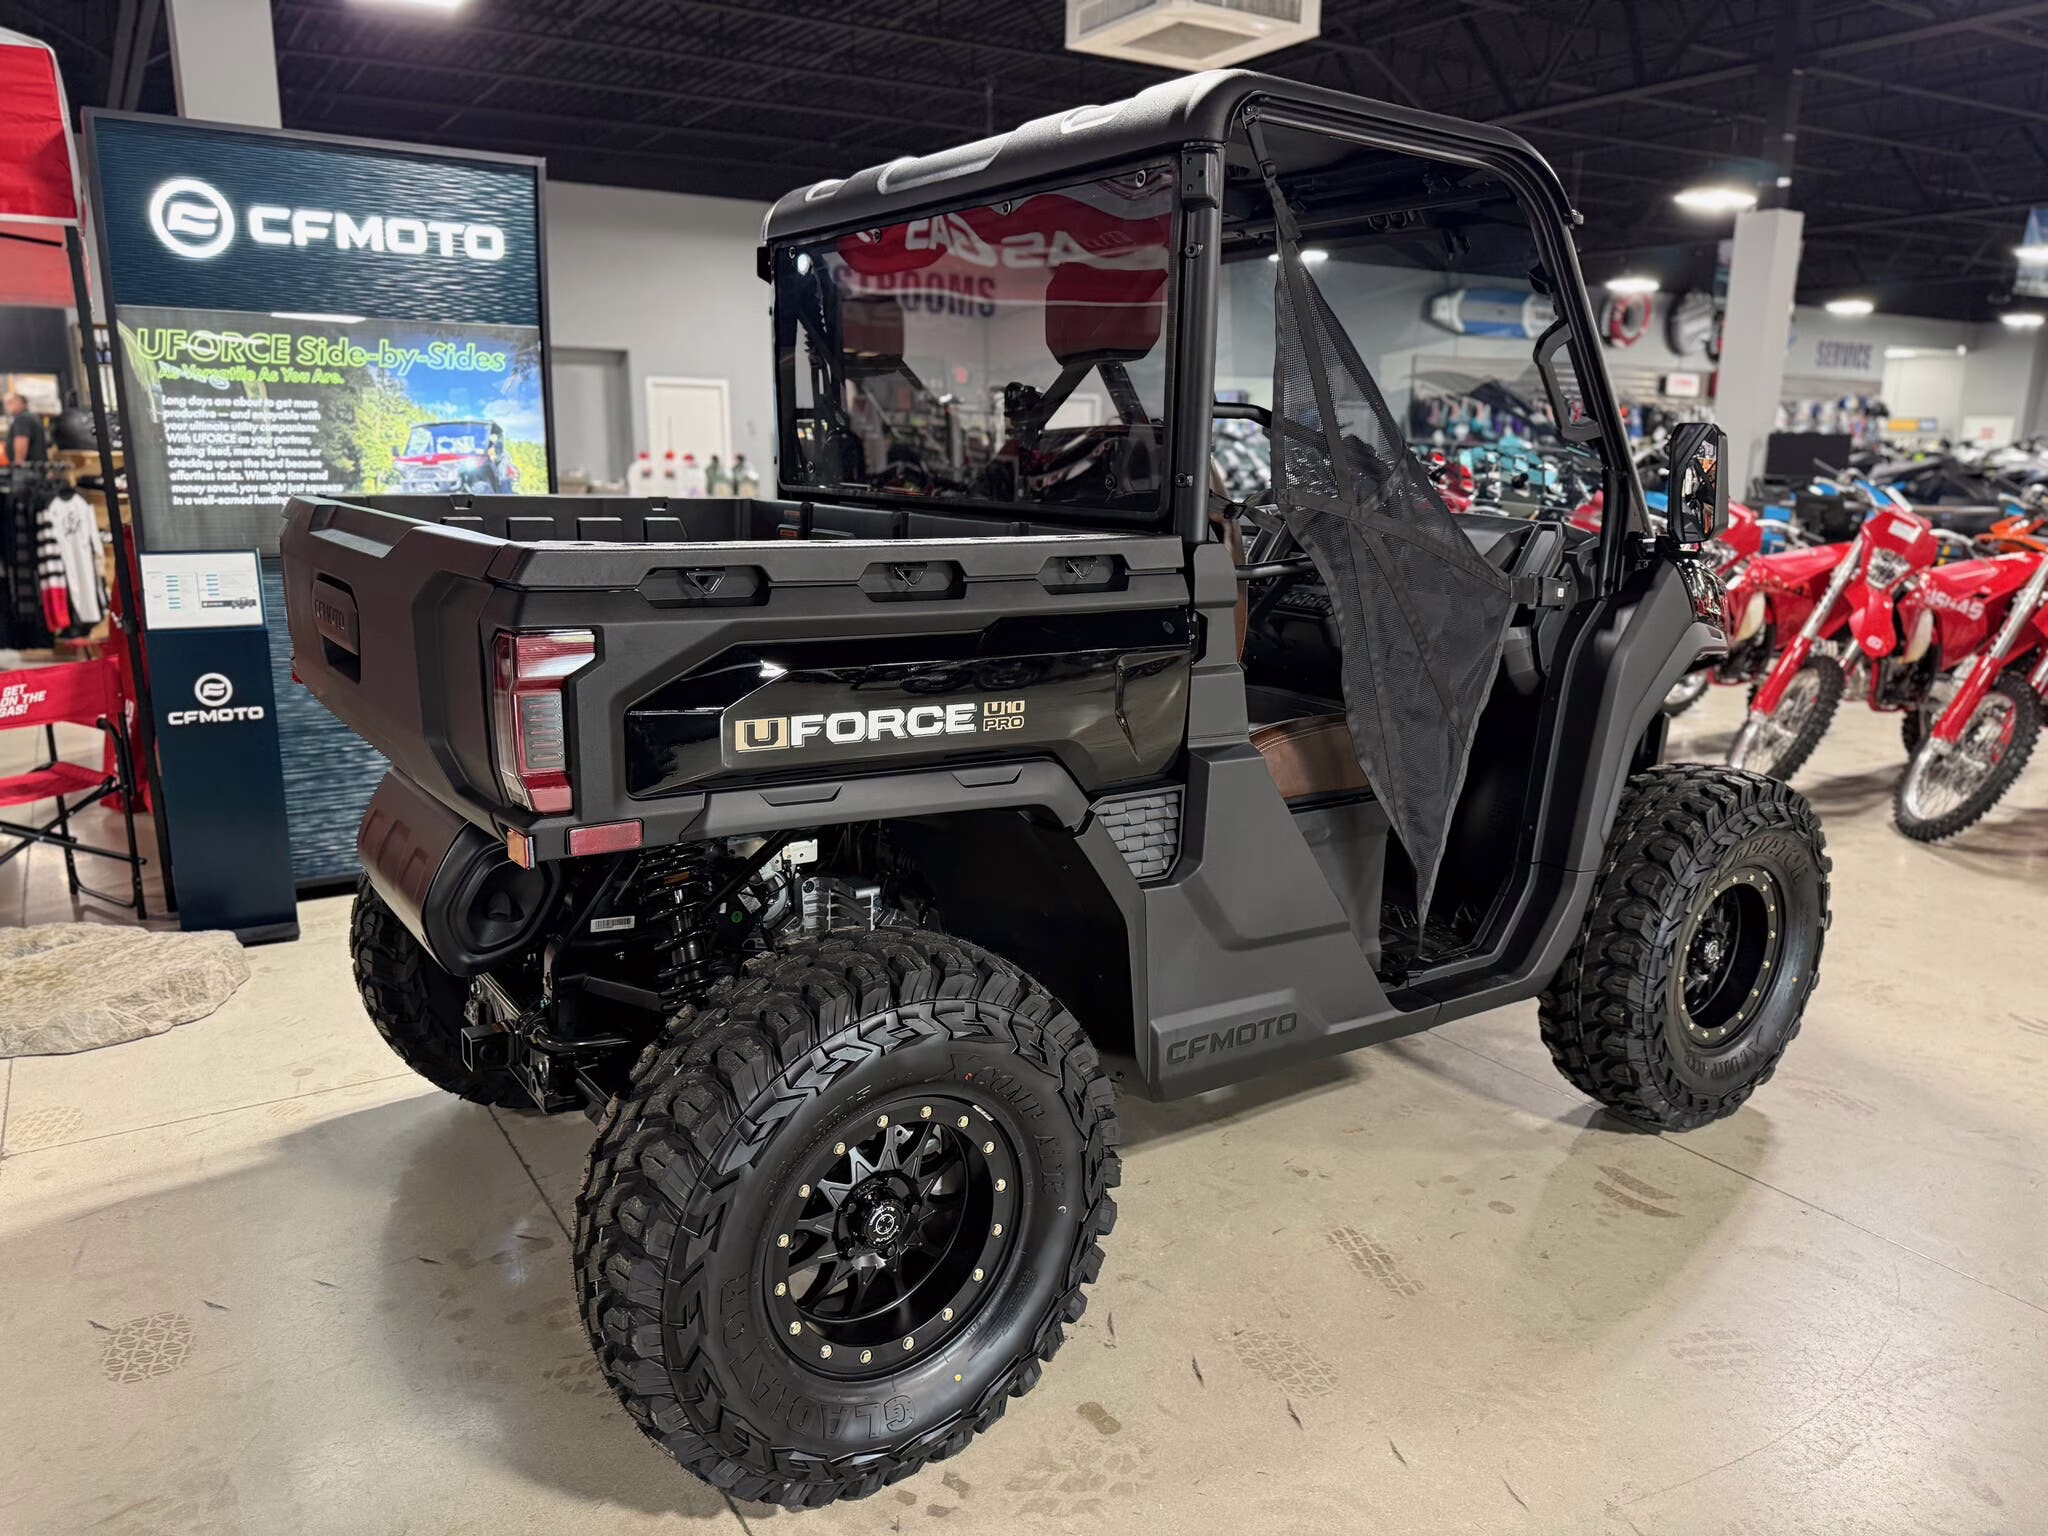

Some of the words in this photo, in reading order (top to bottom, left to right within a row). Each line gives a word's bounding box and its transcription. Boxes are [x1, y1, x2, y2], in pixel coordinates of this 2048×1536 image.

[247, 205, 506, 261] CFMOTO
[137, 328, 291, 364] UFORCE
[296, 335, 506, 376] Side-by-Sides
[158, 366, 180, 379] As
[181, 364, 256, 382] Versatile
[259, 366, 279, 383] As
[280, 367, 310, 384] You
[311, 368, 345, 384] Are.
[162, 395, 187, 408] Long
[188, 395, 213, 408] days
[214, 398, 232, 406] are
[232, 396, 261, 407] about
[276, 398, 292, 410] get
[294, 400, 318, 408] more
[163, 408, 216, 420] productive
[230, 409, 250, 419] and
[251, 410, 299, 422] enjoyable
[300, 410, 321, 420] with
[163, 422, 188, 433] your
[189, 420, 229, 431] ultimate
[231, 421, 259, 434] utility
[260, 423, 319, 434] companions.
[165, 433, 191, 443] With
[192, 433, 237, 443] UFORCE
[274, 435, 312, 446] partner,
[167, 445, 205, 458] hauling
[206, 446, 232, 457] feed,
[233, 446, 276, 459] mending
[277, 447, 309, 457] fences,
[168, 457, 213, 470] checking
[214, 460, 228, 470] up
[229, 460, 242, 468] on
[243, 458, 260, 468] the
[261, 458, 284, 468] herd
[285, 458, 323, 468] become
[169, 470, 216, 481] effortless
[216, 470, 244, 481] tasks.
[244, 470, 269, 480] With
[269, 470, 286, 480] the
[287, 470, 308, 480] time
[309, 470, 329, 480] and
[171, 485, 206, 496] money
[206, 482, 239, 494] saved,
[239, 485, 258, 495] you
[259, 482, 287, 494] might
[288, 483, 305, 494] just
[305, 484, 344, 494] squeeze
[184, 497, 193, 505] a
[193, 494, 254, 505] well-earned
[3, 683, 28, 698] GET
[1, 696, 19, 707] ON
[22, 690, 47, 704] THE
[0, 703, 29, 718] GAS!
[167, 706, 265, 726] CFMOTO
[735, 702, 977, 752] UFORCE
[983, 700, 1025, 716] U10
[983, 715, 1025, 732] PRO
[1166, 1012, 1297, 1065] CFMOTO
